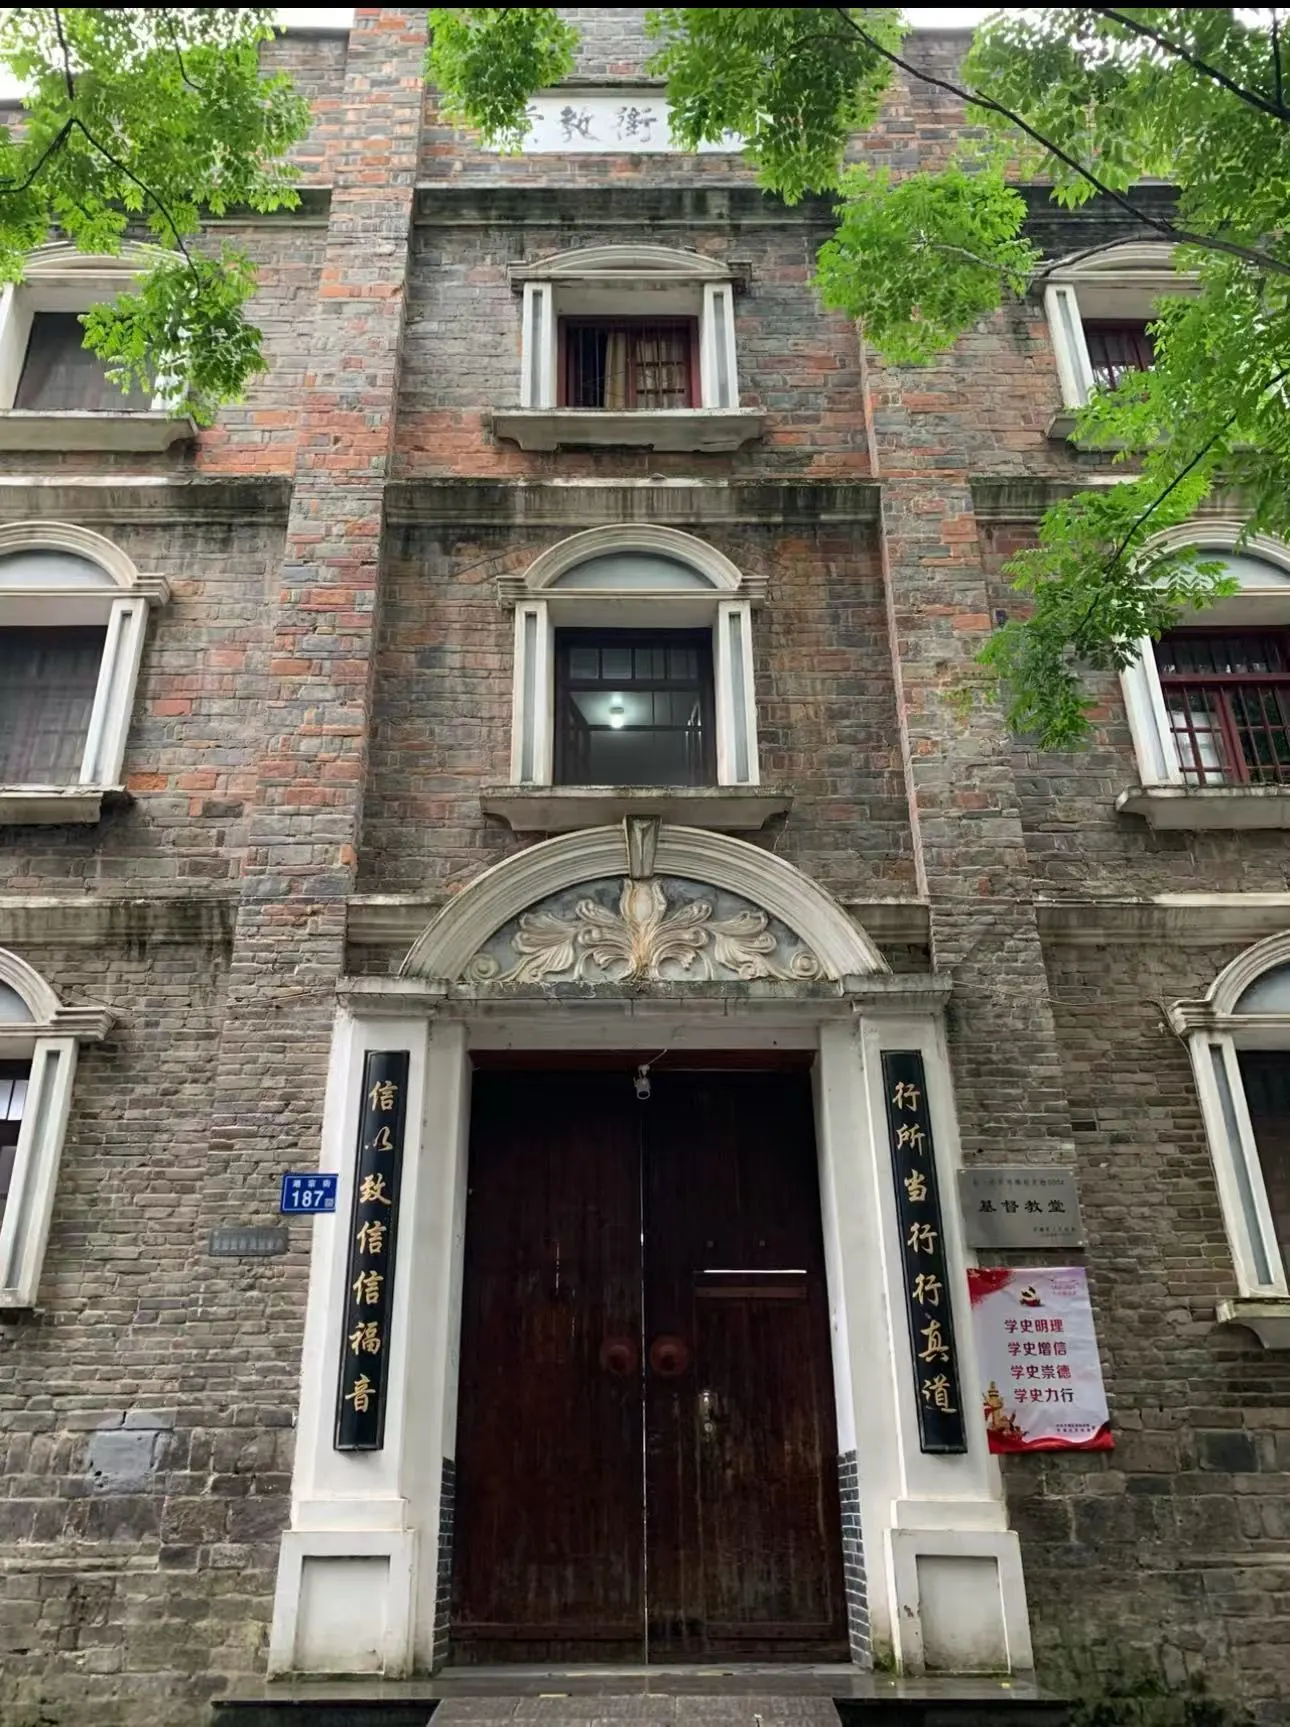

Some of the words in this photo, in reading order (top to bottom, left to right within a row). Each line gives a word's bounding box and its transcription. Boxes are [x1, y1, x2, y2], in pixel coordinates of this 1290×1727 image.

[291, 1190, 324, 1207] 187
[978, 1199, 1066, 1214] 基督教堂
[1004, 1319, 1065, 1333] 学史明理
[1007, 1341, 1068, 1356] 学史增信
[1010, 1364, 1072, 1380] 学史崇德
[1013, 1387, 1074, 1403] 学史力行
